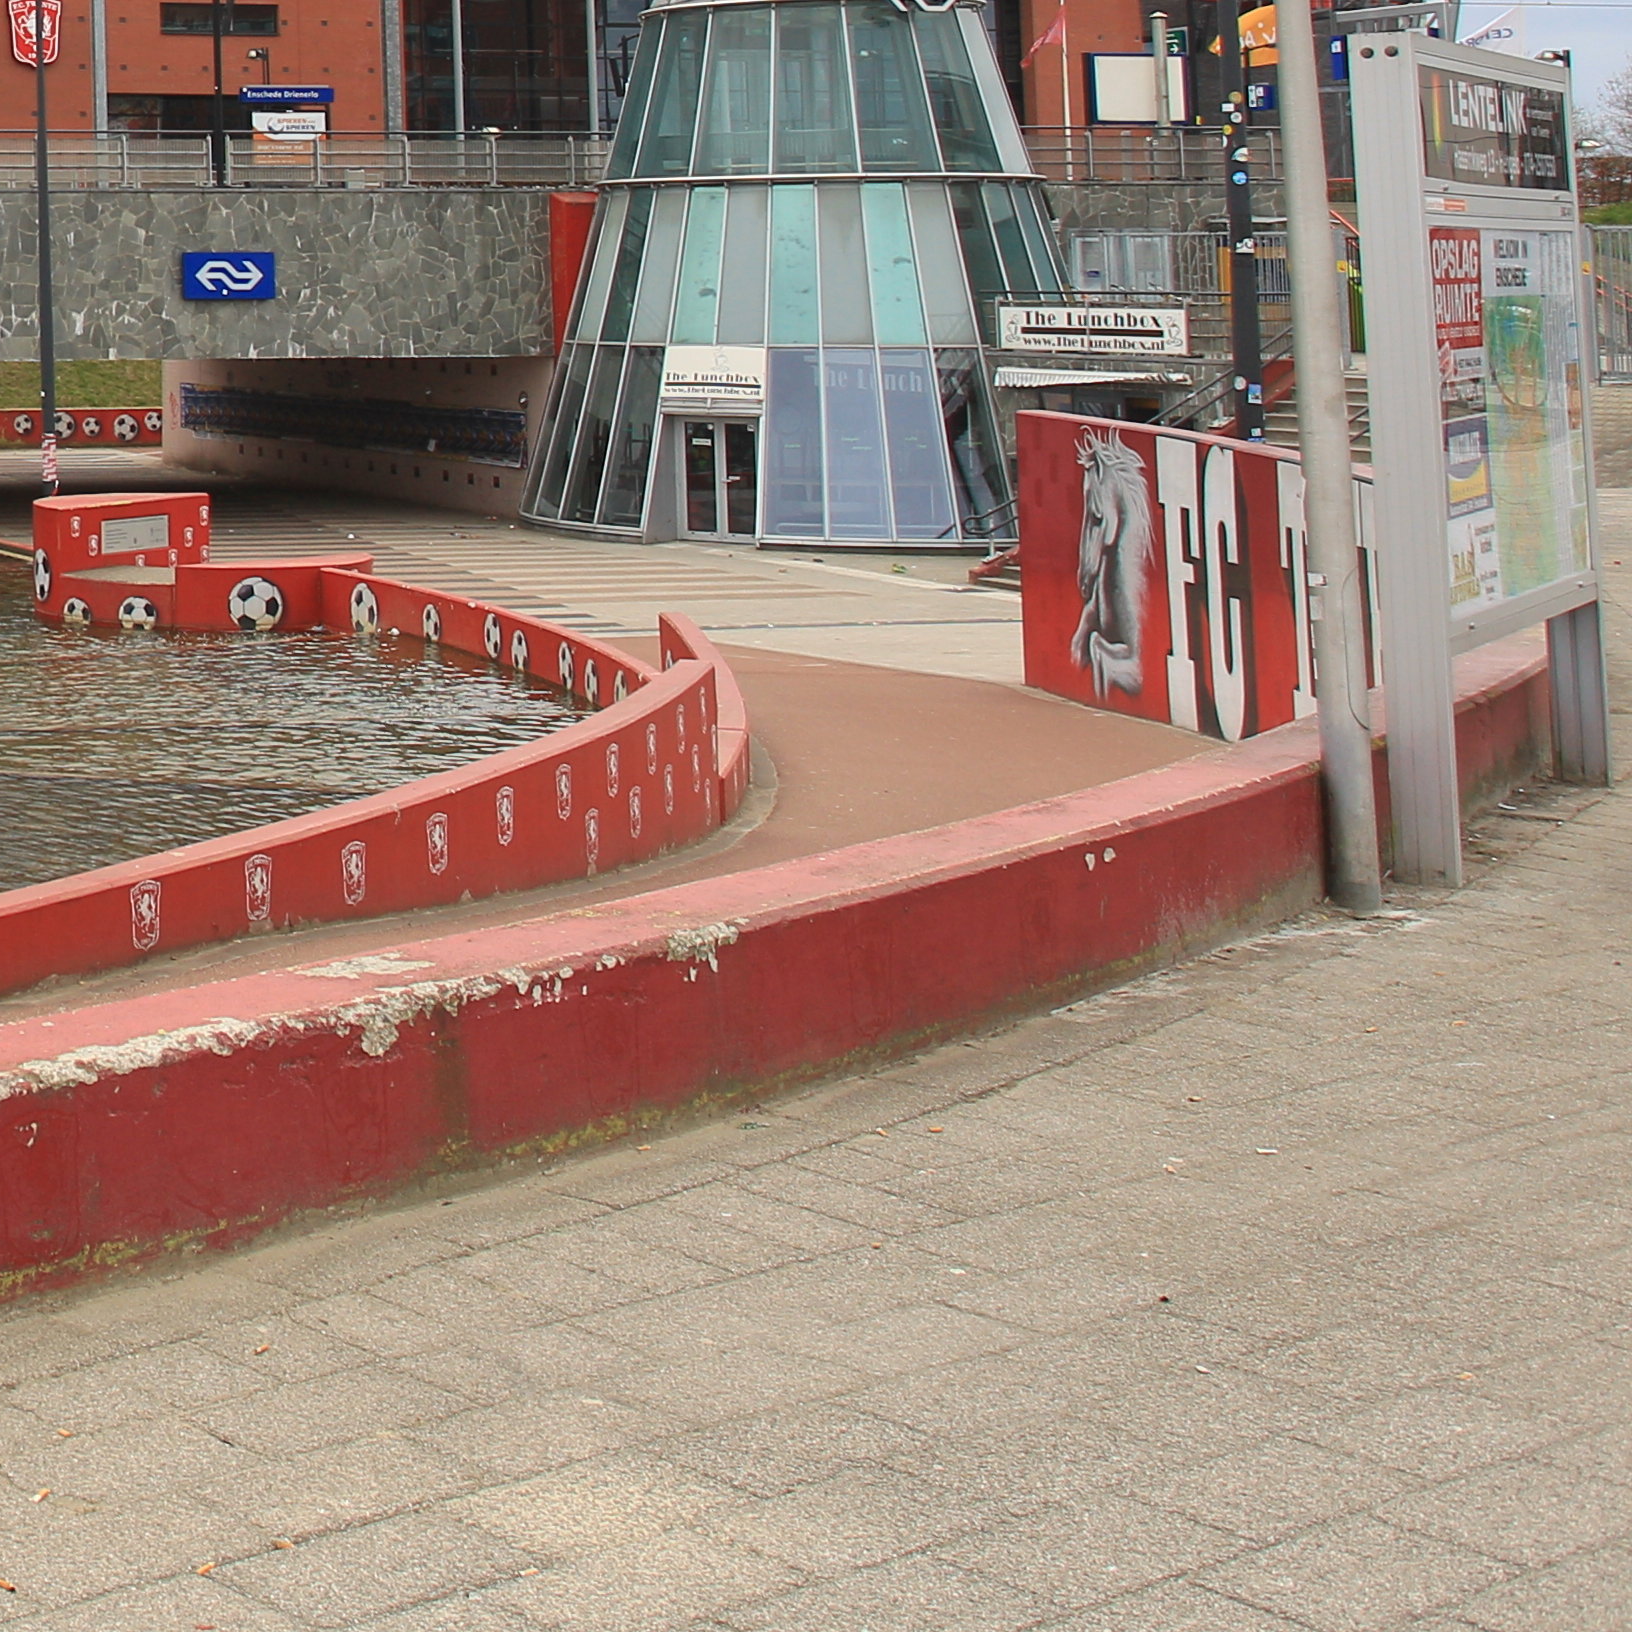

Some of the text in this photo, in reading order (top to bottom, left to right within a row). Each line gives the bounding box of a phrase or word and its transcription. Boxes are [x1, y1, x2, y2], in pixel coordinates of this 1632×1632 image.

[247, 90, 319, 99] Enschede Drienerlo
[1449, 79, 1528, 135] LENTELINK
[1431, 239, 1478, 280] OPSLAG
[1024, 311, 1162, 328] The Lunchbox
[1435, 283, 1480, 325] RUIMTE
[666, 372, 760, 383] The Lunchbox
[1156, 435, 1244, 743] FC
